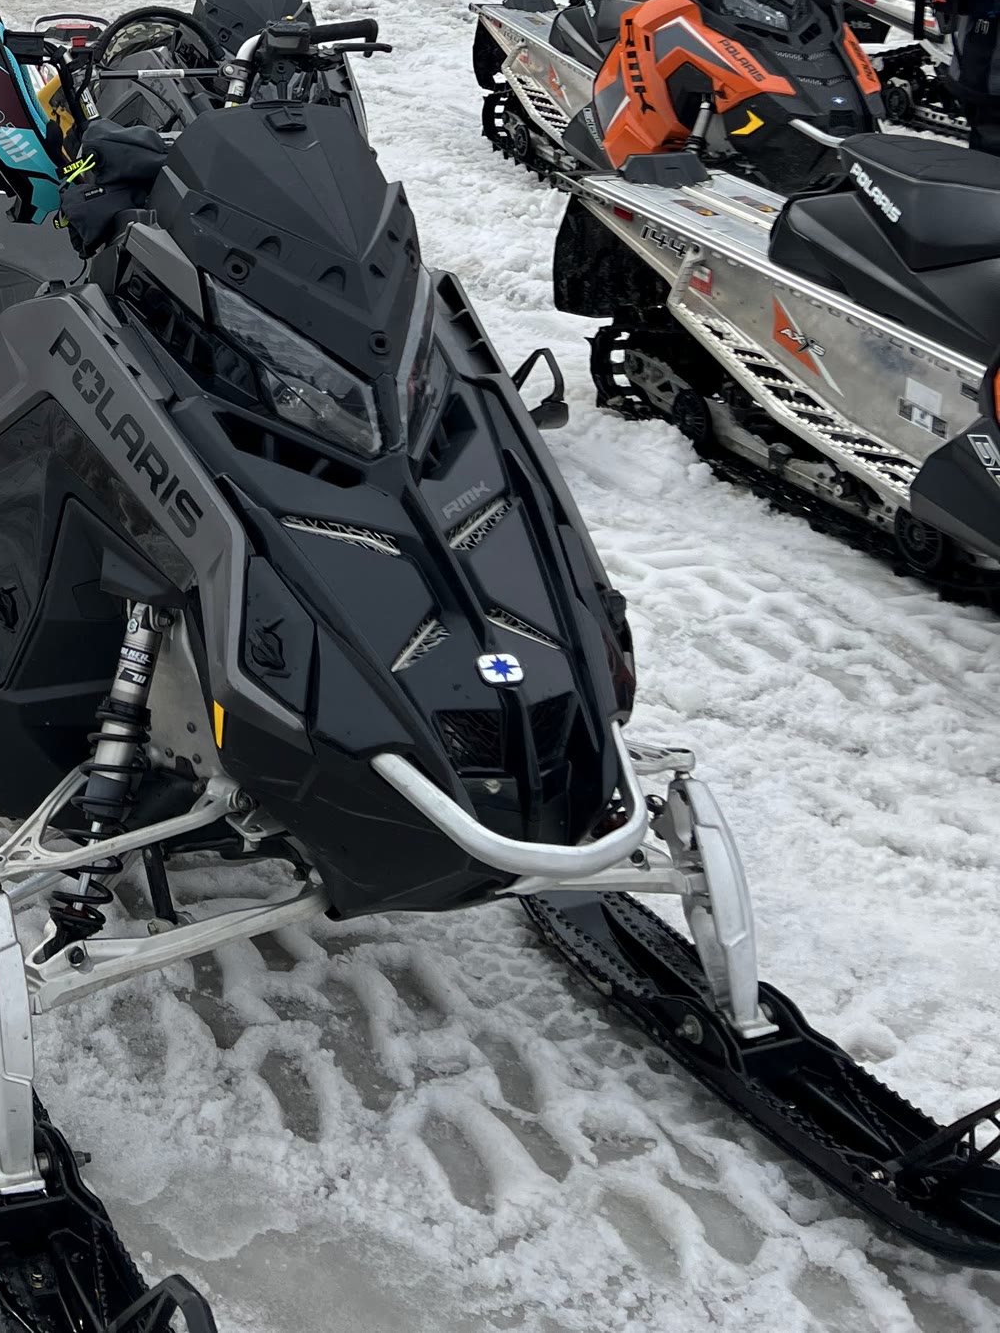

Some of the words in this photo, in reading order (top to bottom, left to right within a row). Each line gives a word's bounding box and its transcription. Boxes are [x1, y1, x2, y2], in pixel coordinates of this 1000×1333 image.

[718, 38, 766, 82] POLARIS
[850, 162, 902, 223] POLARIS
[48, 327, 204, 539] POLARIS
[441, 480, 491, 519] RMK
